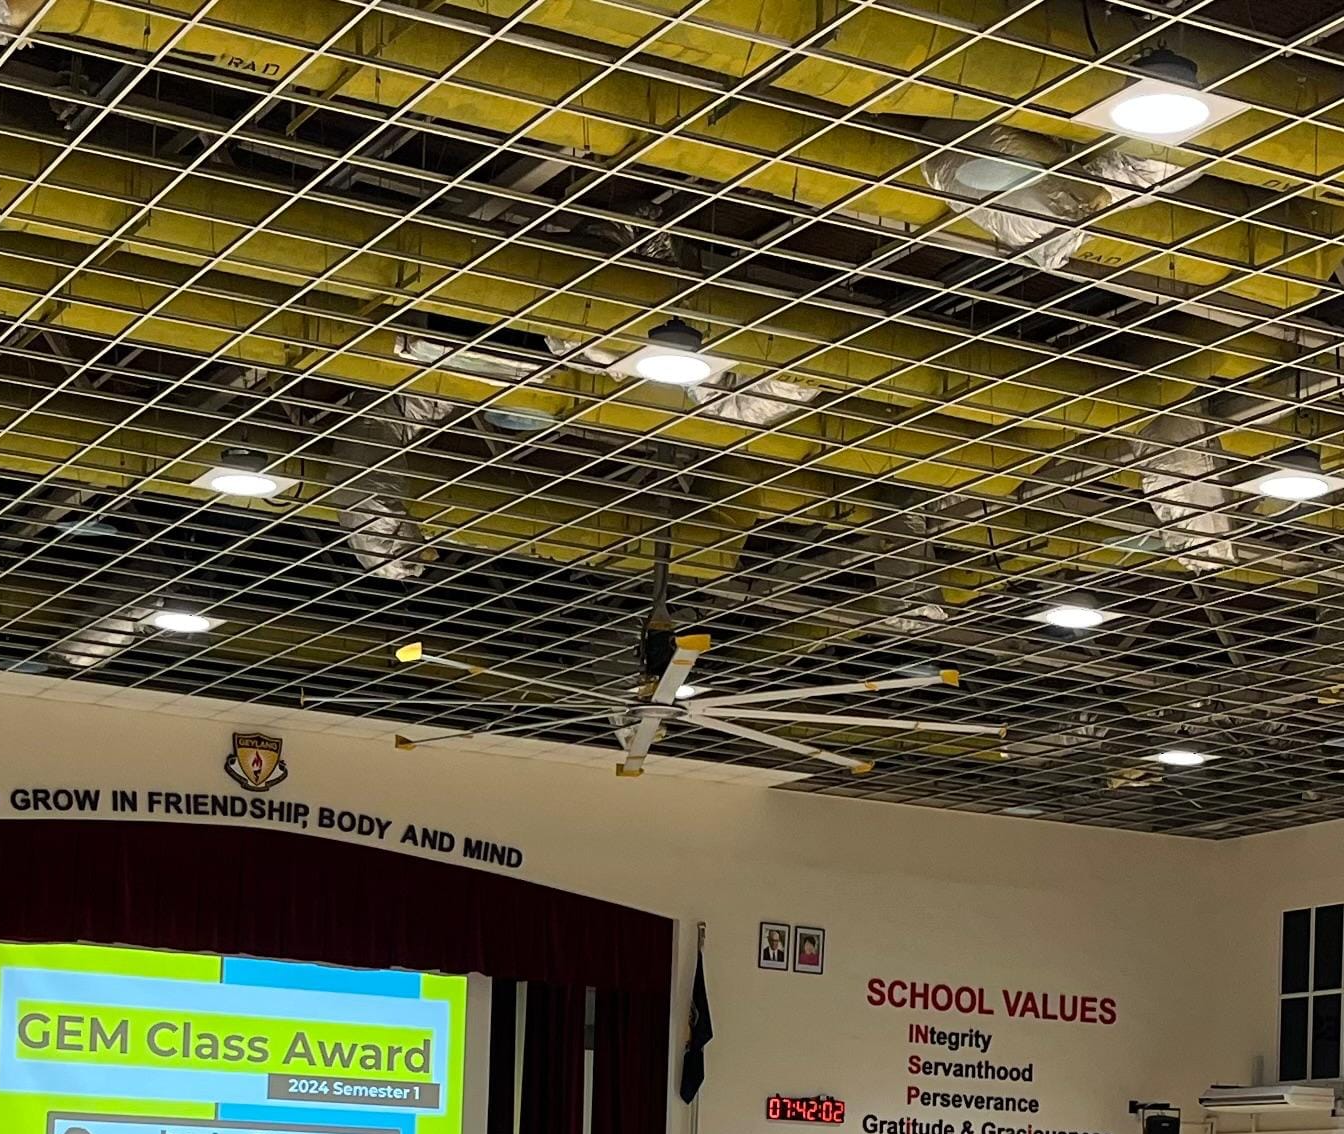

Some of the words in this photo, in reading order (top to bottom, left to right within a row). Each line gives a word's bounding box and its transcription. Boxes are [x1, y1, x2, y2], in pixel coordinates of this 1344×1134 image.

[10, 788, 101, 812] GROW
[111, 790, 138, 812] IN
[147, 791, 309, 829] FRIENDSHIP,
[318, 808, 392, 839] BODY
[400, 825, 455, 853] AND
[462, 837, 523, 868] MIND
[867, 978, 994, 1015] SCHOOL
[1002, 990, 1116, 1024] VALUES
[17, 1012, 129, 1054] GEM
[146, 1021, 270, 1063] Class
[281, 1031, 431, 1074] Award
[909, 1024, 992, 1053] INtegrity
[908, 1055, 1033, 1082] Servanthood
[287, 1078, 330, 1096] 2024
[332, 1081, 410, 1100] Semester
[411, 1086, 420, 1100] 1
[907, 1086, 1039, 1113] Perseverance
[768, 1098, 844, 1123] 07:42:02
